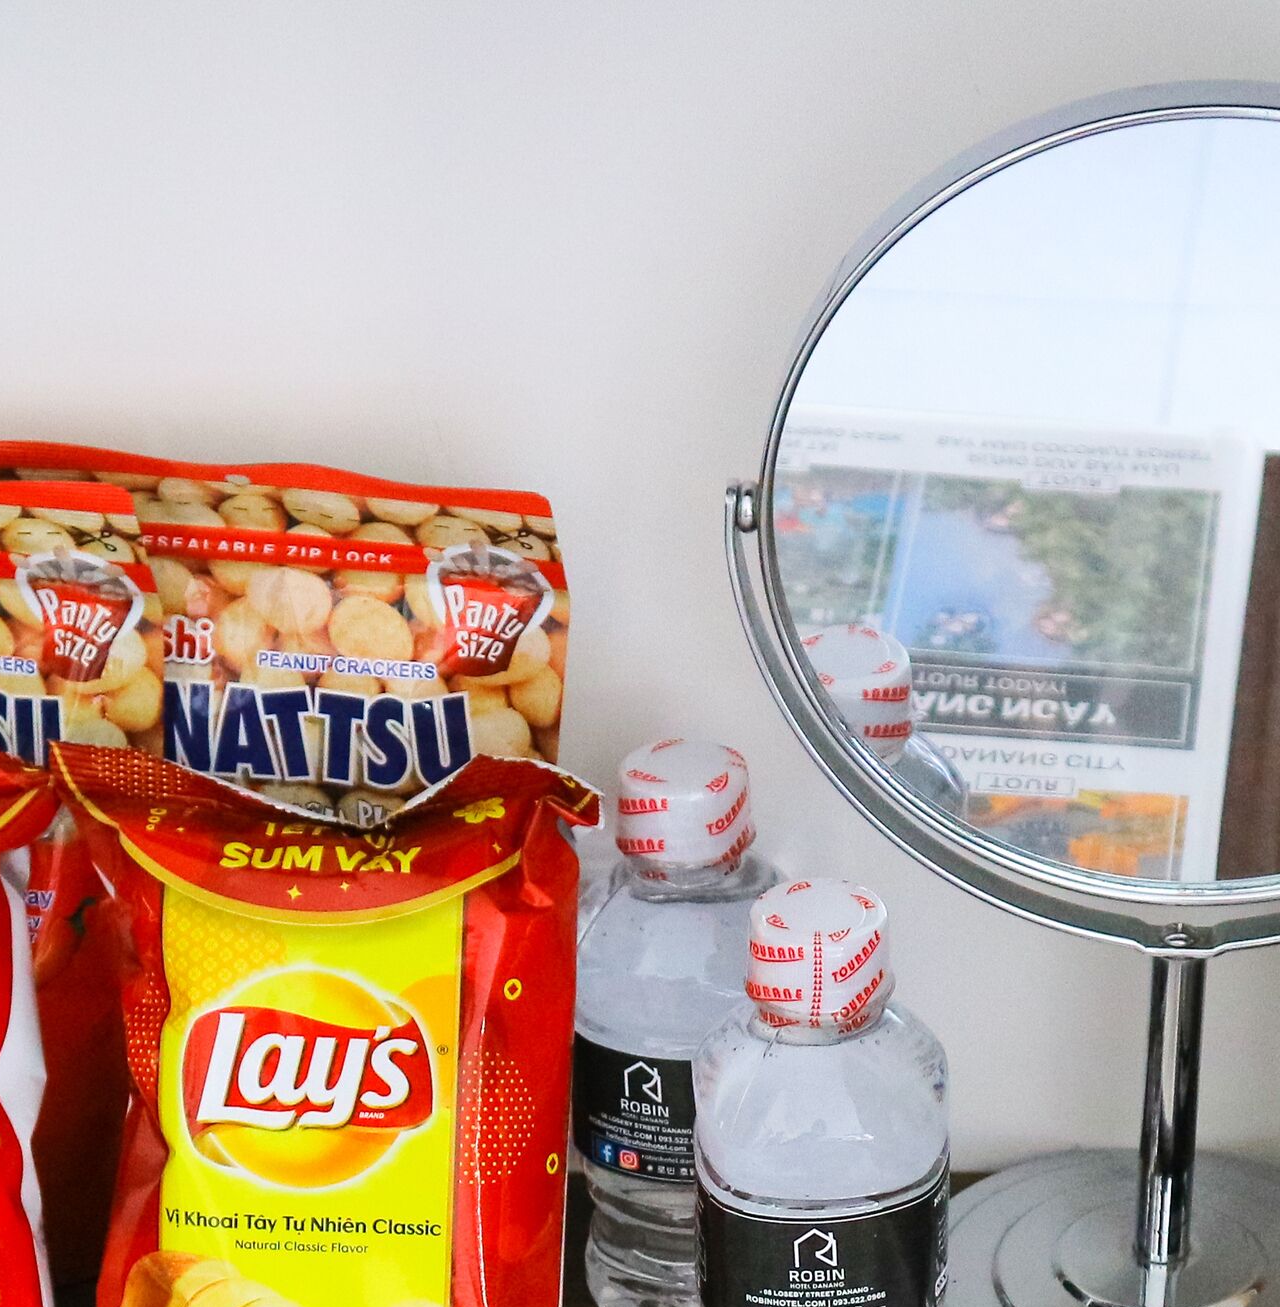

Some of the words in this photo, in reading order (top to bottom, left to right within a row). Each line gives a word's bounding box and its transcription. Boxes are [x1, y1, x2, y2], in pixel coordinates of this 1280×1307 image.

[286, 543, 322, 560] ZIP
[331, 549, 394, 567] LOCK
[256, 649, 331, 674] PEANUT
[332, 655, 438, 681] CRACKERS
[219, 841, 323, 873] SUM
[195, 1012, 419, 1131] Lay's
[359, 1111, 385, 1120] BRAND
[620, 1098, 670, 1118] ROBIN
[165, 1208, 180, 1229] Vị
[184, 1211, 239, 1231] Khoai
[243, 1212, 278, 1235] Tây
[282, 1213, 306, 1236] Tự
[310, 1214, 368, 1235] Nhiên
[372, 1217, 442, 1237] Classic
[234, 1239, 281, 1252] Natural
[284, 1240, 327, 1253] Classic
[330, 1241, 369, 1254] Flavor
[788, 1268, 846, 1283] ROBIN
